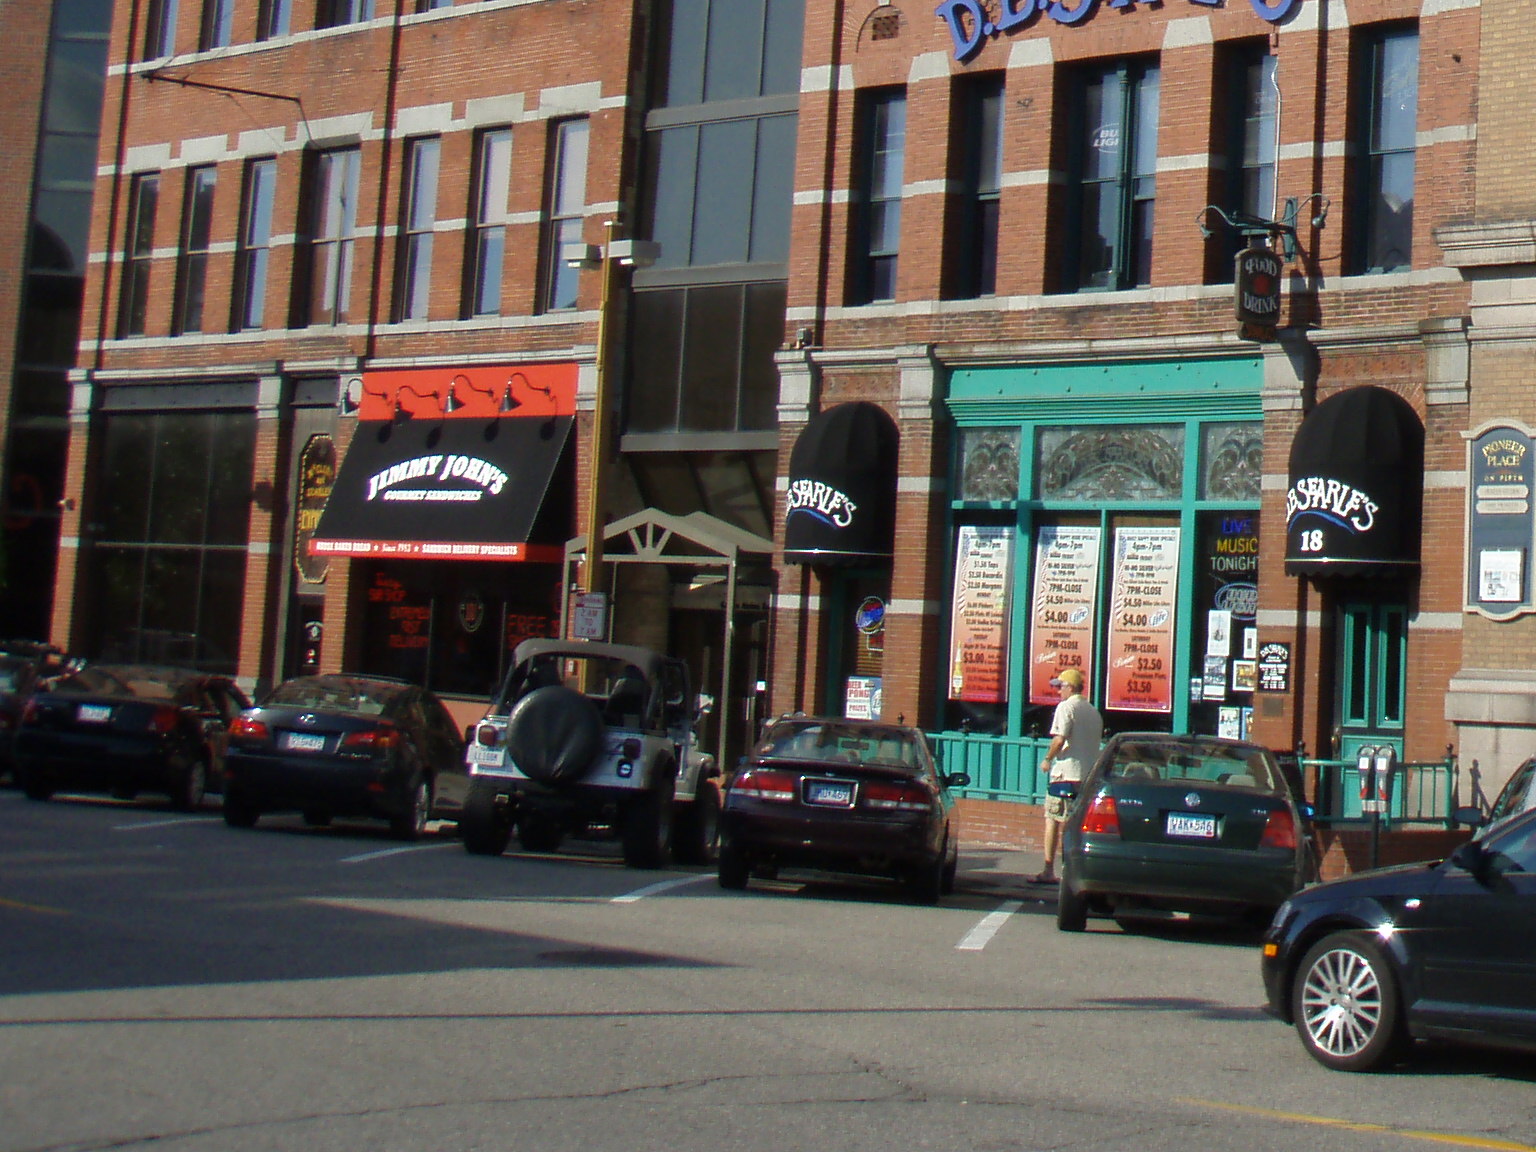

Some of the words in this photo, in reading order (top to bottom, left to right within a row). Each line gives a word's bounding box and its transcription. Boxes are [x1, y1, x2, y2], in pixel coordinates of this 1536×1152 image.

[1245, 258, 1278, 276] FOOD
[1244, 291, 1278, 314] DRINK
[1482, 439, 1526, 457] PIONEER
[1487, 455, 1520, 466] PLACE
[368, 454, 443, 500] JIMMY
[439, 454, 509, 495] JOHN'S
[1499, 474, 1524, 482] FIFTH
[384, 490, 426, 500] GOURMET
[425, 490, 483, 501] SANDWICHES
[1297, 477, 1379, 531] SEARLE'S
[1222, 519, 1252, 534] LIVE
[1216, 537, 1258, 553] MUSIC
[1301, 529, 1323, 551] 18
[1049, 583, 1082, 593] 7PM-CLOSE
[1126, 586, 1161, 595] 7PM-CLOSE
[1045, 610, 1068, 623] $4.00
[1123, 613, 1147, 627] $4.00
[507, 614, 547, 636] FREE
[1124, 644, 1158, 653] 7PM-CLOSE
[1059, 654, 1081, 666] $2.50
[1138, 657, 1162, 671] $2.50
